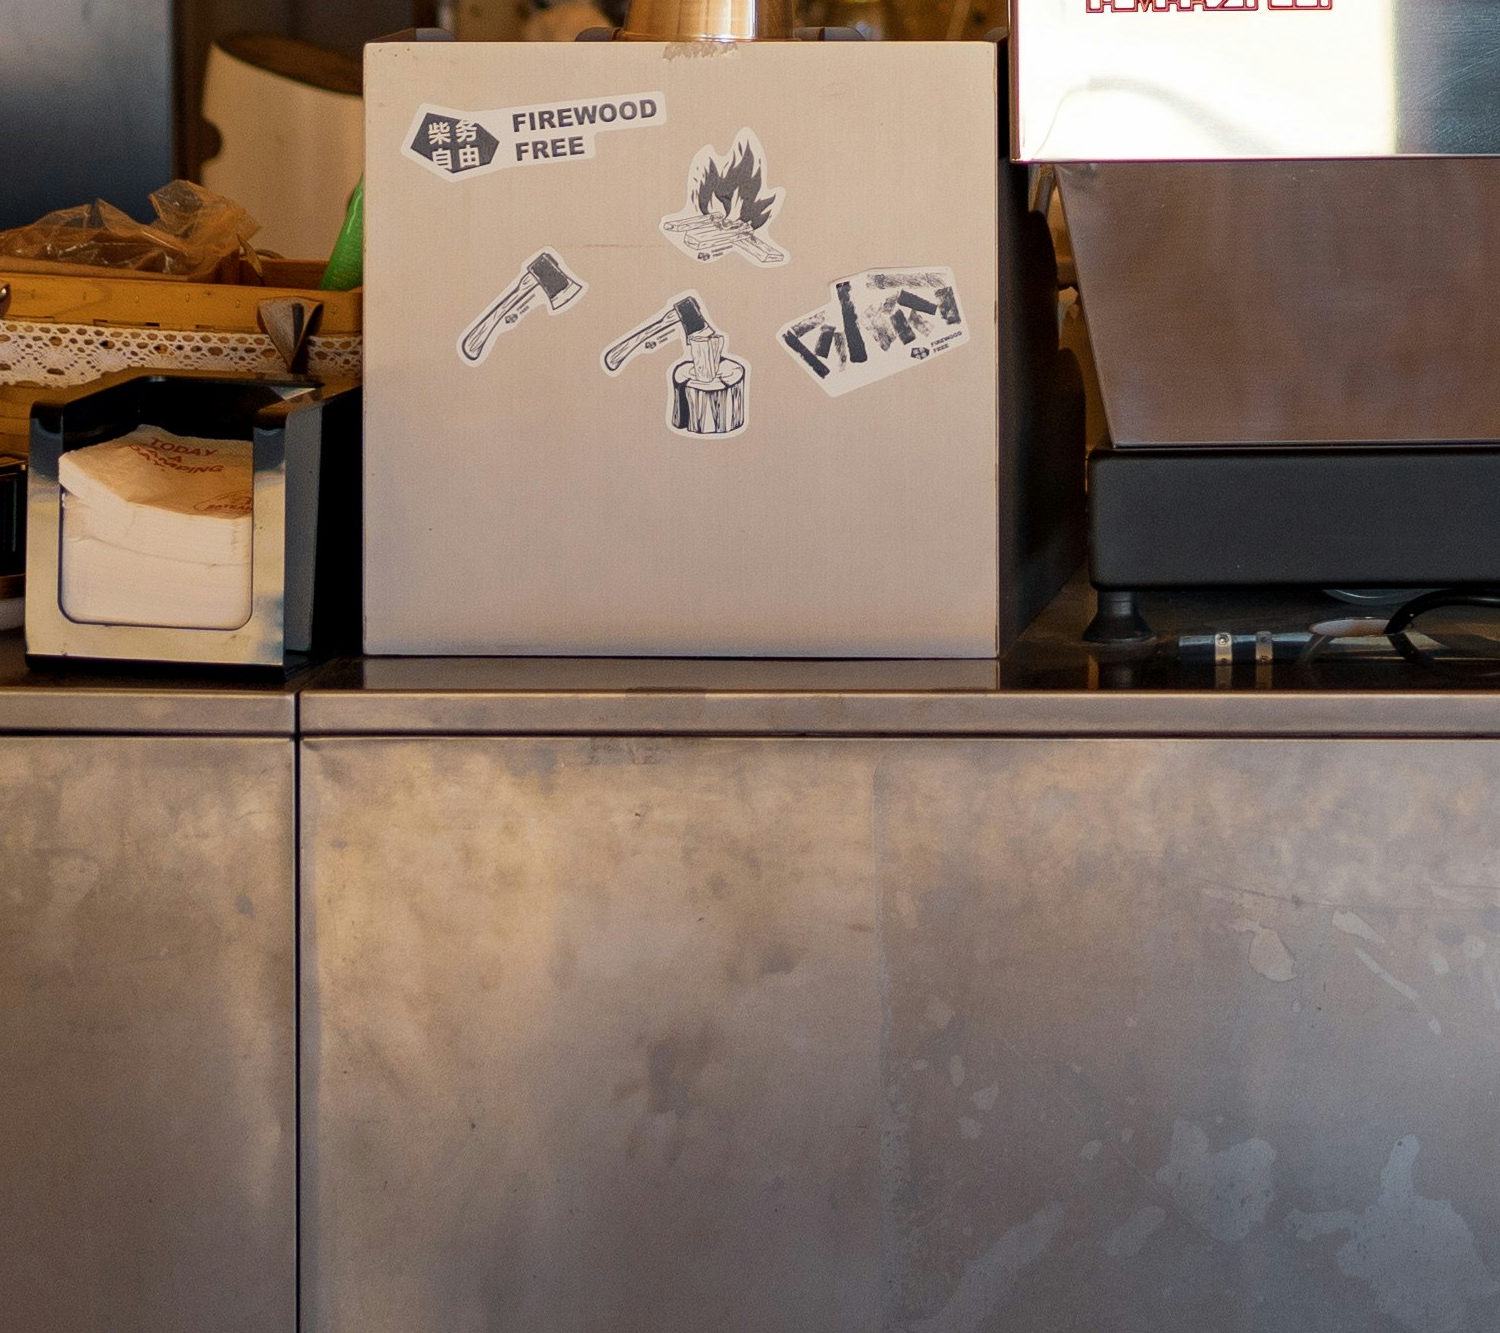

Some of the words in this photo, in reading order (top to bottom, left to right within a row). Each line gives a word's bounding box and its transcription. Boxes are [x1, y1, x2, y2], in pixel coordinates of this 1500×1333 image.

[512, 99, 658, 133] FIREWOOD
[515, 136, 585, 161] FREE
[152, 437, 218, 456] TODAY
